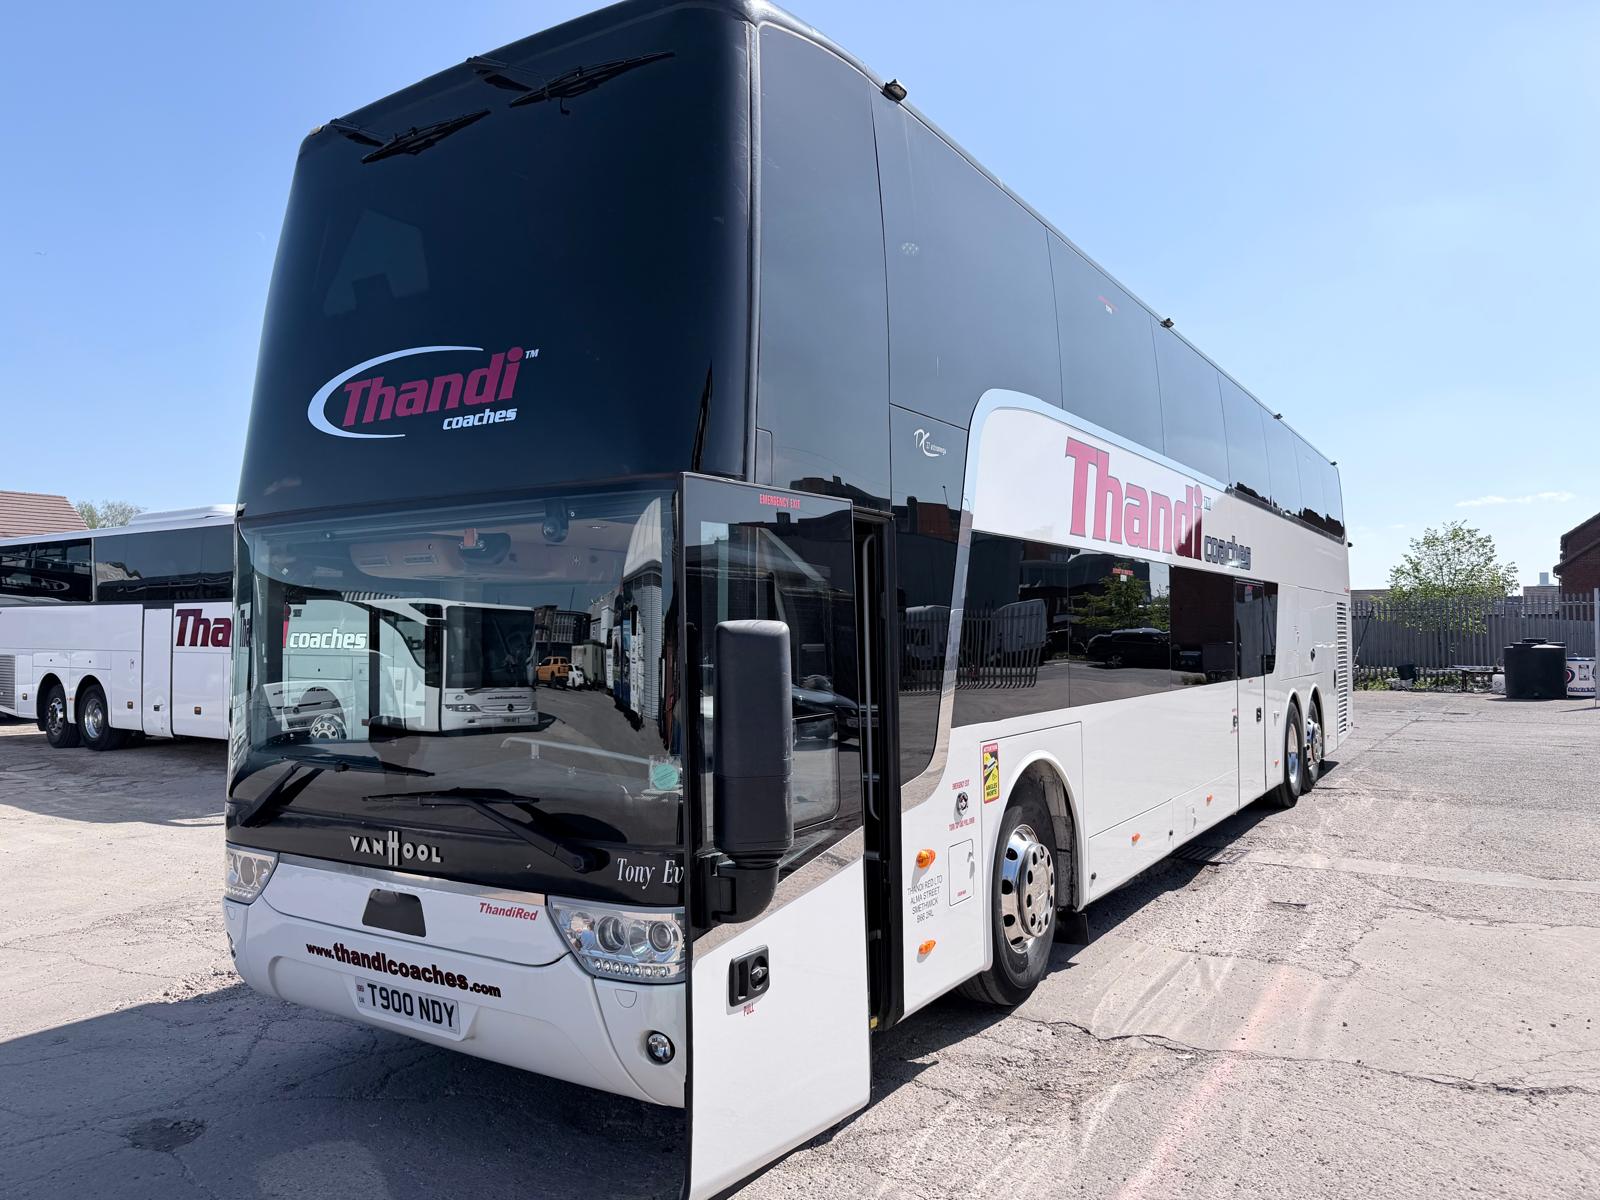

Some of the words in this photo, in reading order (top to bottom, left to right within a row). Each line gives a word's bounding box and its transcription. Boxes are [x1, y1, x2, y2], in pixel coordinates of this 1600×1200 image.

[342, 347, 523, 427] Thandi
[442, 408, 517, 430] coaches
[1065, 437, 1202, 561] Thandi
[1204, 535, 1252, 571] coaches
[289, 629, 367, 649] coaches
[617, 857, 655, 890] Tony
[479, 902, 539, 921] ThandiRed
[306, 942, 502, 998] www.thandicoaches.com
[367, 983, 414, 1017] T900
[418, 996, 455, 1028] NDY
